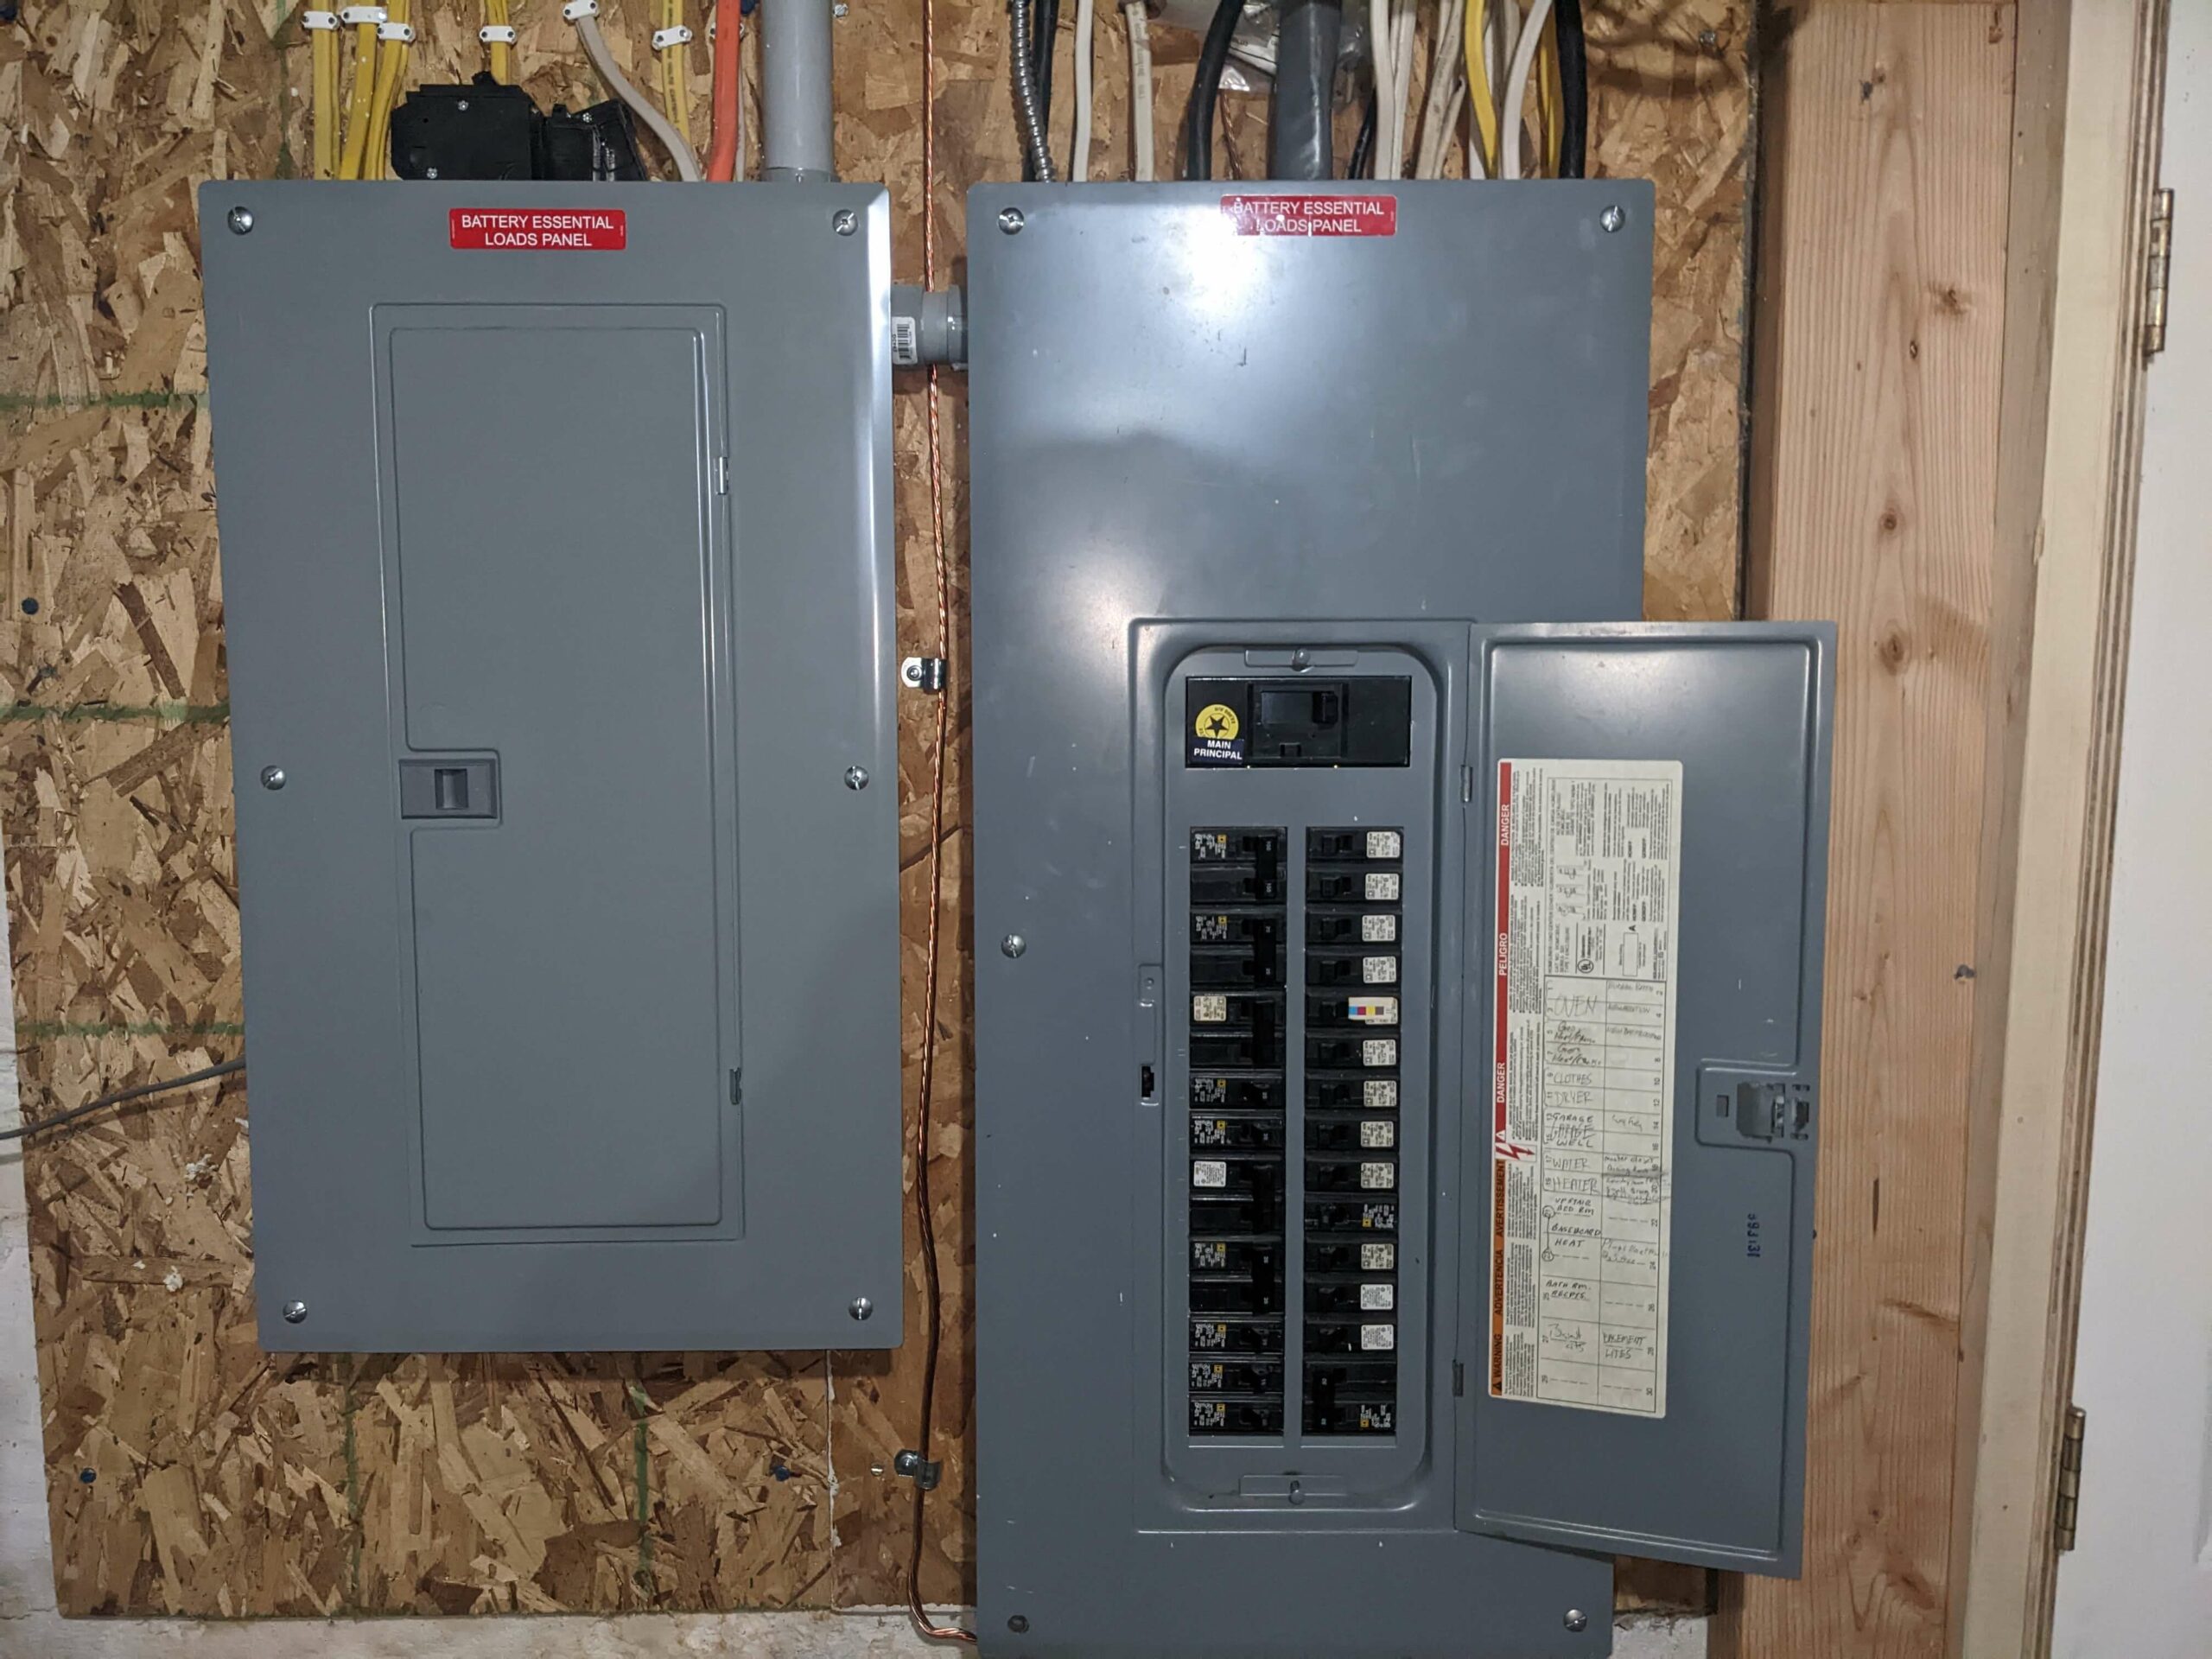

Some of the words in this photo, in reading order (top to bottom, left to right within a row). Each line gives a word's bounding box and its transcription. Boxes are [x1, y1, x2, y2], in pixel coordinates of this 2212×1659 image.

[1233, 201, 1299, 215] BATTERY
[1303, 201, 1384, 215] ESSENTIAL
[461, 214, 528, 228] BATTERY
[532, 215, 613, 229] ESSENTIAL
[1256, 219, 1307, 232] LOADS
[1313, 219, 1362, 232] PANEL
[485, 232, 537, 245] LOADS
[542, 233, 592, 246] PANEL
[1207, 740, 1231, 749] MAIN
[1193, 747, 1243, 760] PRINCIPAL
[1500, 804, 1510, 847] DANGER
[1498, 932, 1508, 976] PELIGRO
[1554, 995, 1598, 1017] OVEN
[1497, 1062, 1506, 1103] DANGER
[1554, 1072, 1592, 1085] CLOTHES
[1654, 1077, 1661, 1086] 10
[1555, 1090, 1594, 1106] DRYER
[1654, 1098, 1660, 1107] 12
[1553, 1114, 1594, 1123] GARAGE
[1653, 1121, 1659, 1129] 14
[1556, 1139, 1594, 1148] WELL
[1652, 1142, 1659, 1151] 16
[1554, 1157, 1591, 1170] WATER
[1554, 1178, 1600, 1194] HEATER
[1495, 1160, 1505, 1238] AVERTISSEMENT
[1554, 1239, 1586, 1248] HEAT
[1493, 1249, 1503, 1314] ADVERTENCIA
[1546, 1279, 1568, 1287] BATH
[1493, 1333, 1503, 1378] WARNING
[1605, 1348, 1631, 1359] LITES
